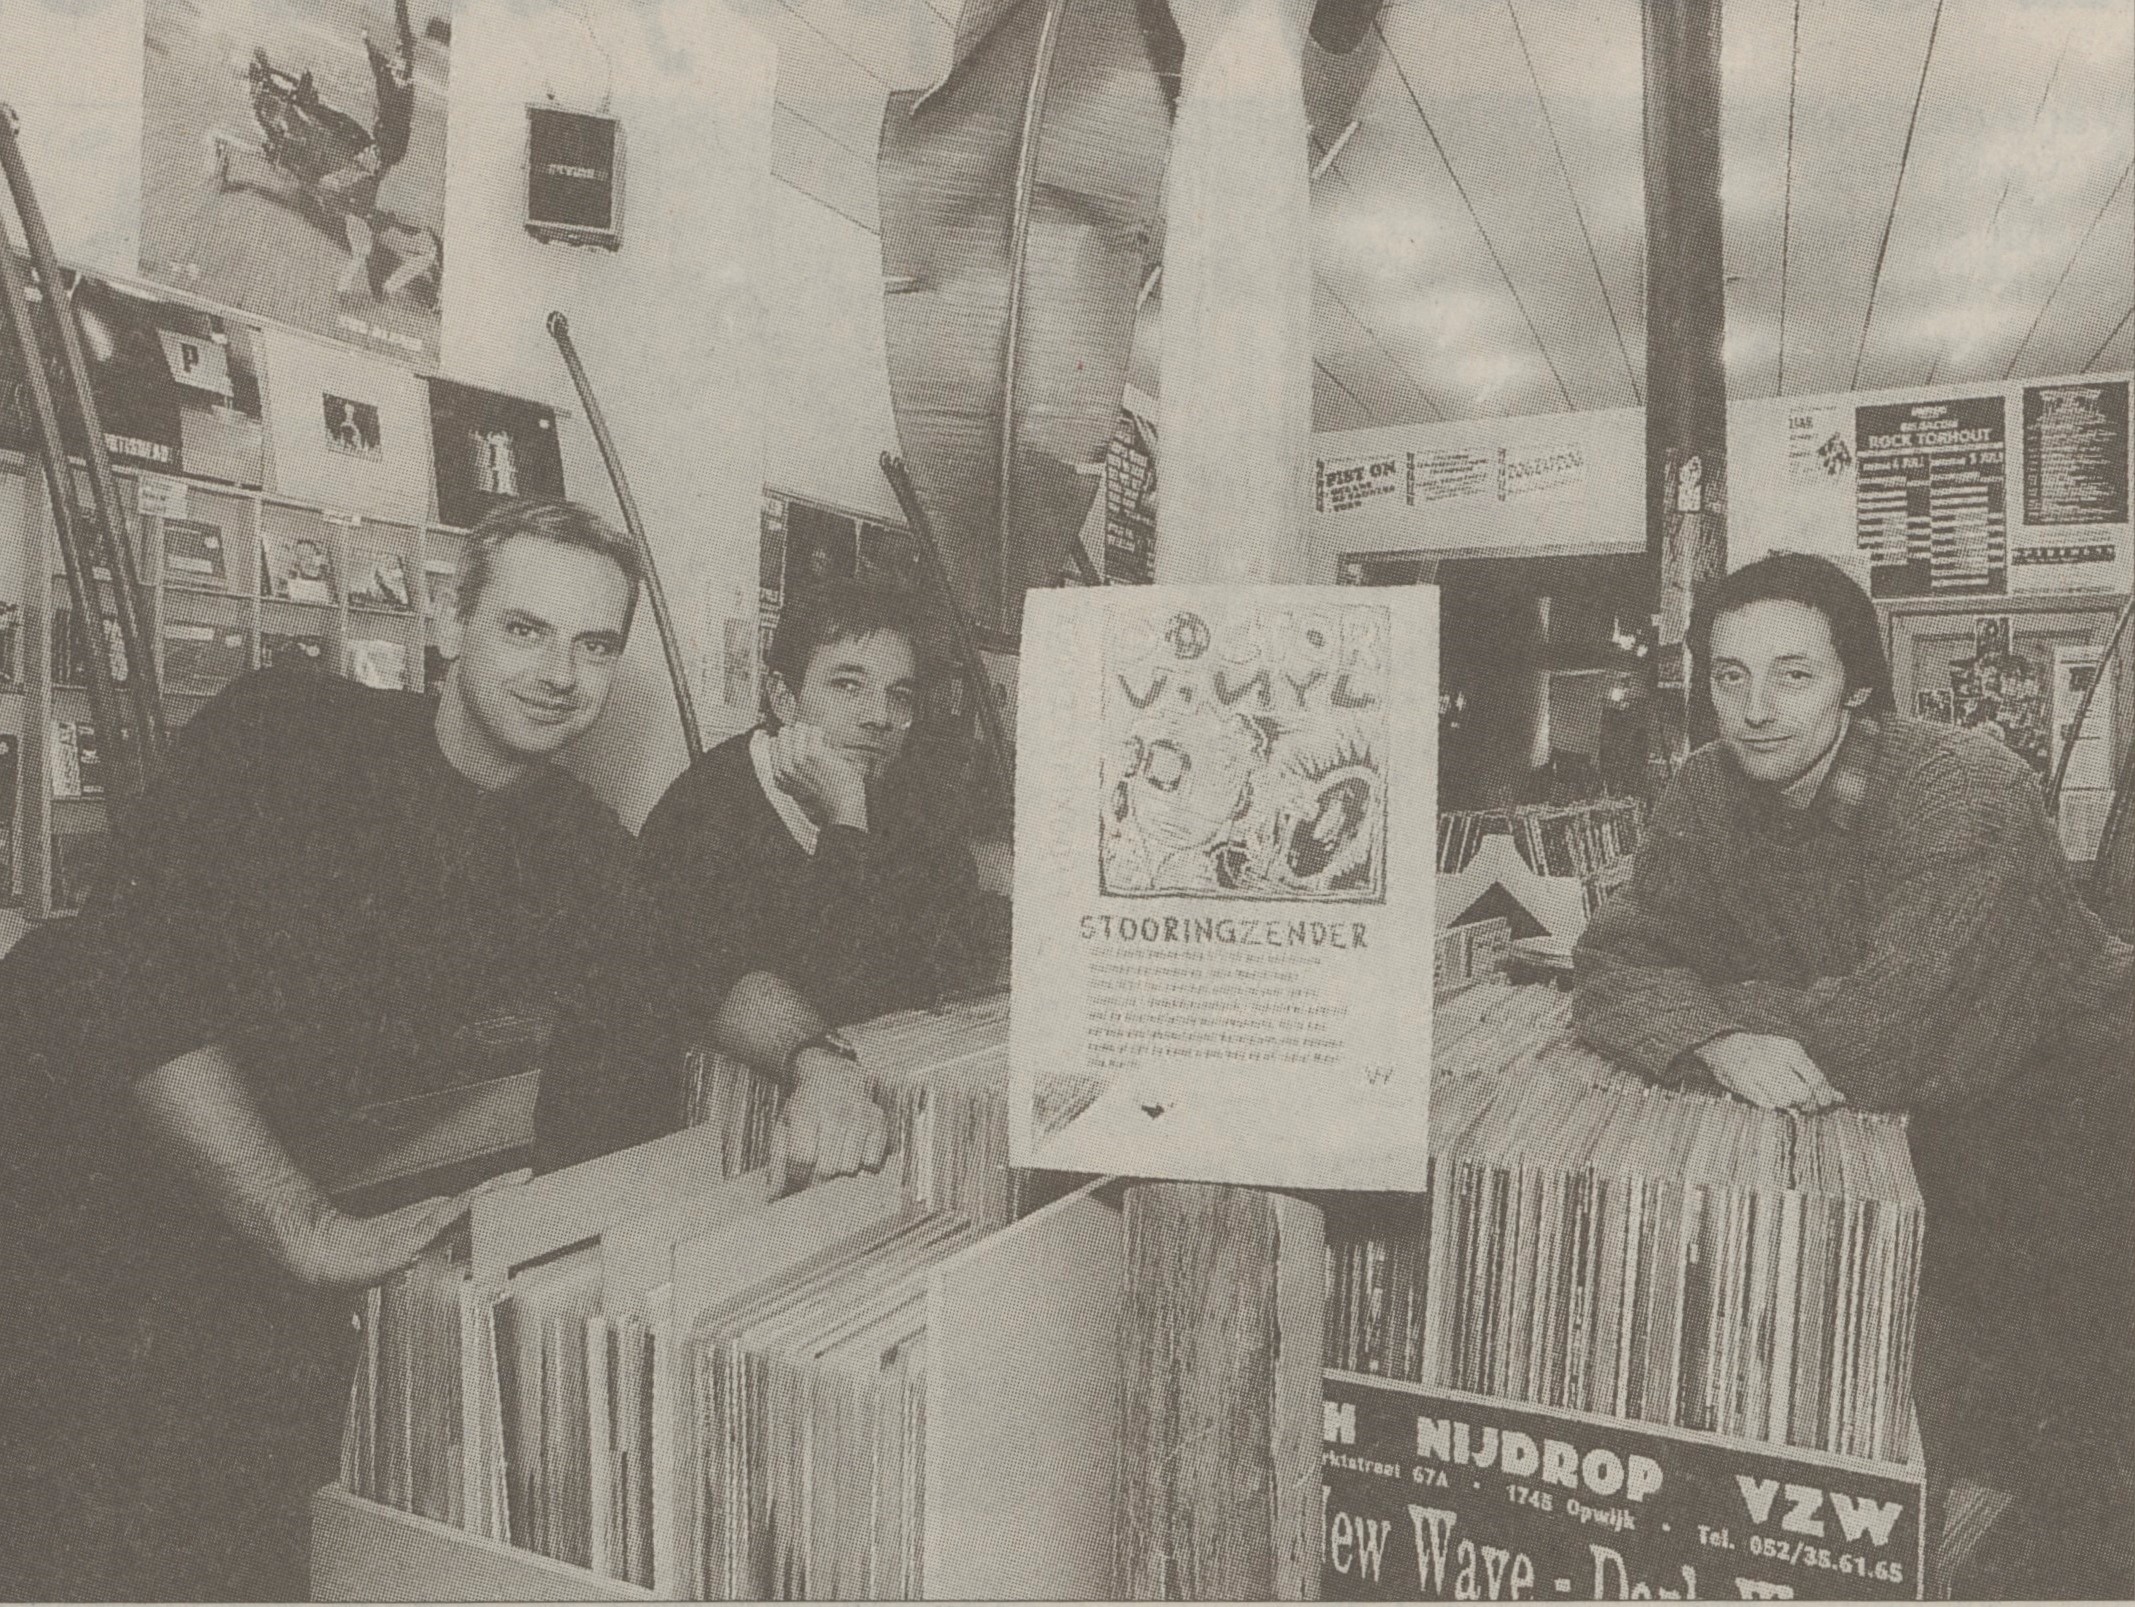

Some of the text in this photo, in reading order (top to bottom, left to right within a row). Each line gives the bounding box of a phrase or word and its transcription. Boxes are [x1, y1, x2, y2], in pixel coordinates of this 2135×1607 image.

[1369, 459, 1397, 479] ON
[1079, 914, 1369, 950] STOORINGZENDER
[1412, 1465, 1450, 1488] 67A
[1506, 1484, 1553, 1512] 1745
[1566, 1498, 1636, 1532] Opwijk
[1697, 1524, 1736, 1550] Tel.
[1749, 1534, 1904, 1584] 052/35.61.65
[1416, 1415, 1664, 1502] NIJDROP
[1735, 1473, 1904, 1547] VZW
[1406, 1503, 1535, 1600] Wave
